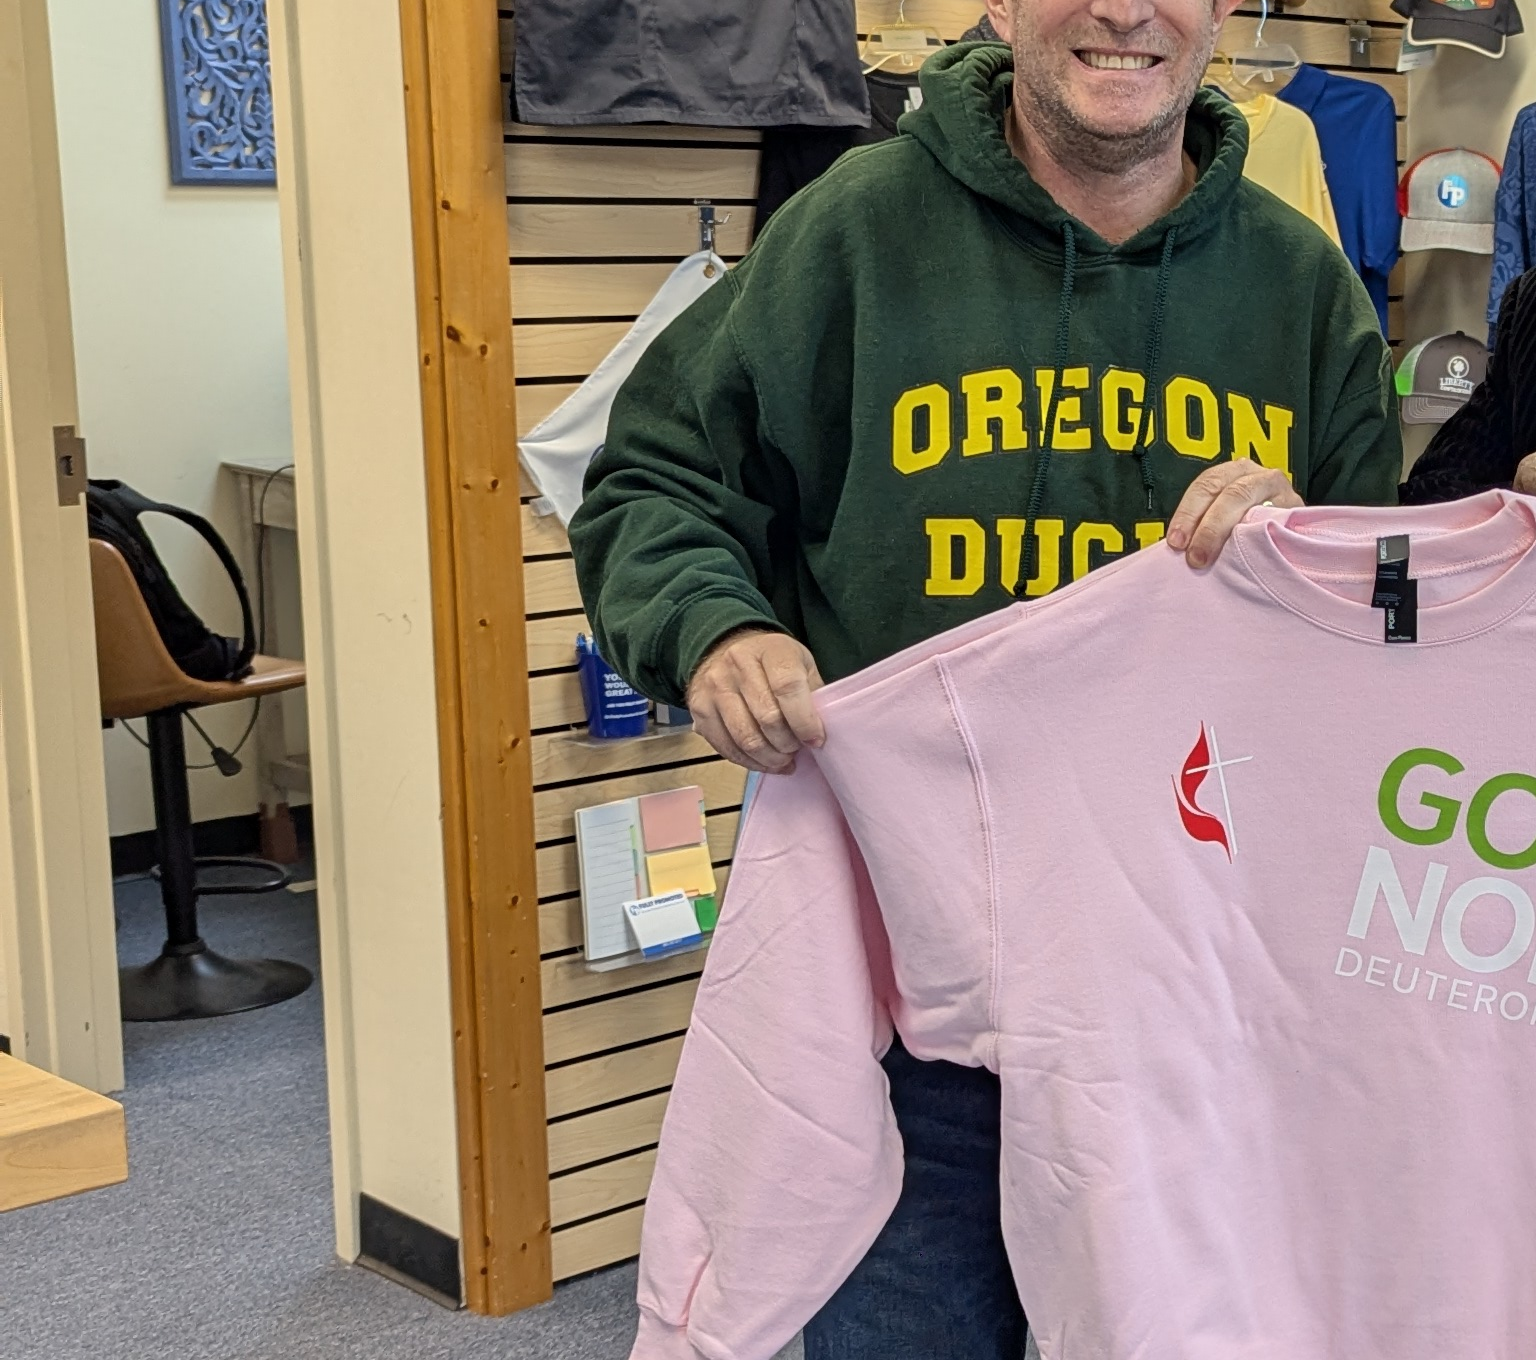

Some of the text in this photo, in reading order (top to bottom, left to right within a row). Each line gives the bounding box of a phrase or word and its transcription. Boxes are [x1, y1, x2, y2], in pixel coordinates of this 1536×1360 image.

[1441, 179, 1465, 206] FP
[890, 366, 1295, 483] OREGON
[924, 517, 1166, 597] DUC
